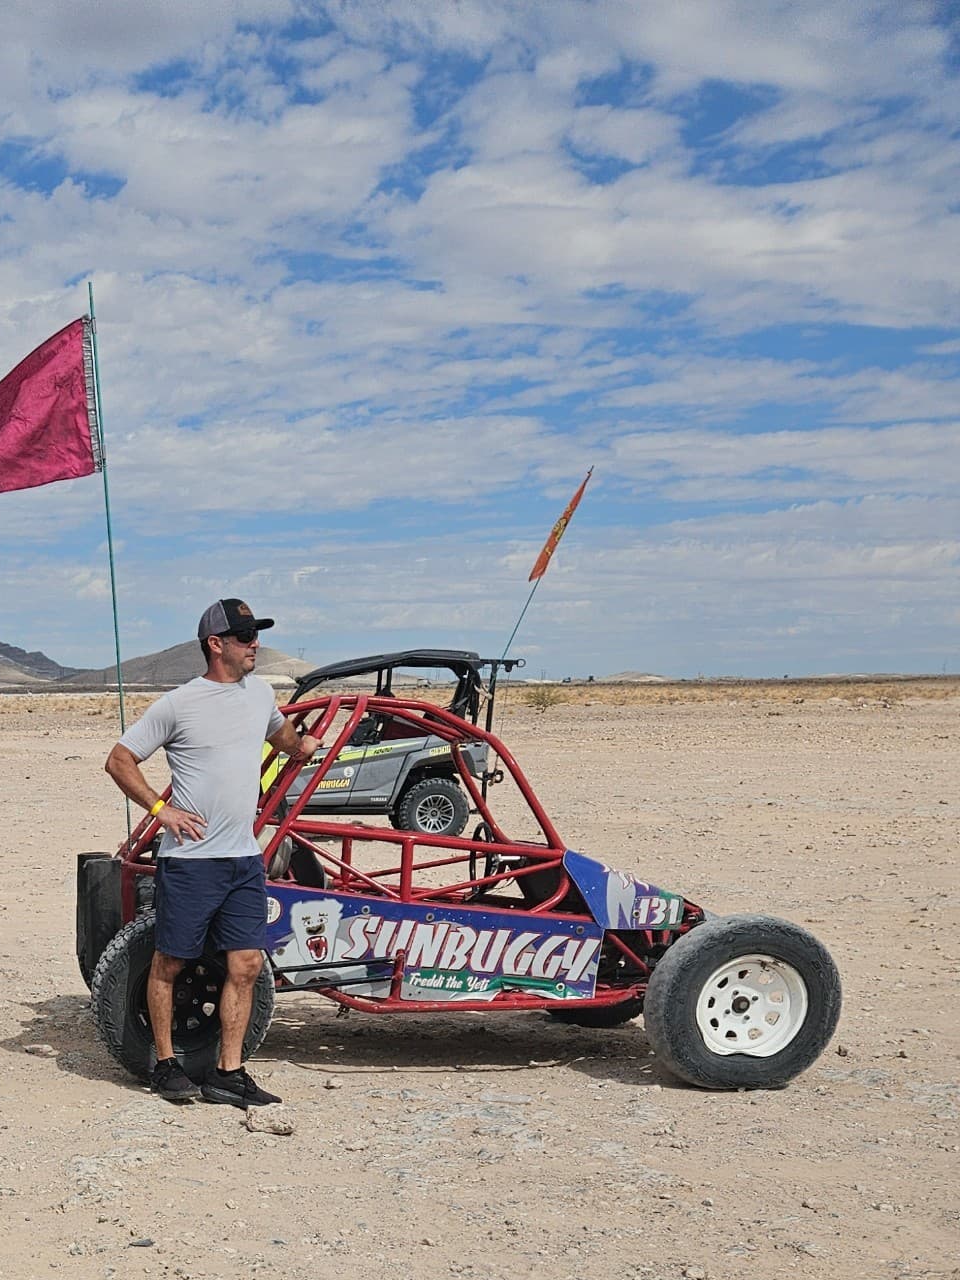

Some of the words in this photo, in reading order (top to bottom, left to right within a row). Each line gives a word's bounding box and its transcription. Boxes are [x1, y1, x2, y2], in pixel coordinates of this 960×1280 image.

[638, 897, 680, 925] 131
[340, 914, 601, 982] SUNBUGGY
[409, 972, 445, 989] Freddi
[445, 975, 463, 989] the
[466, 975, 490, 992] Yeti
